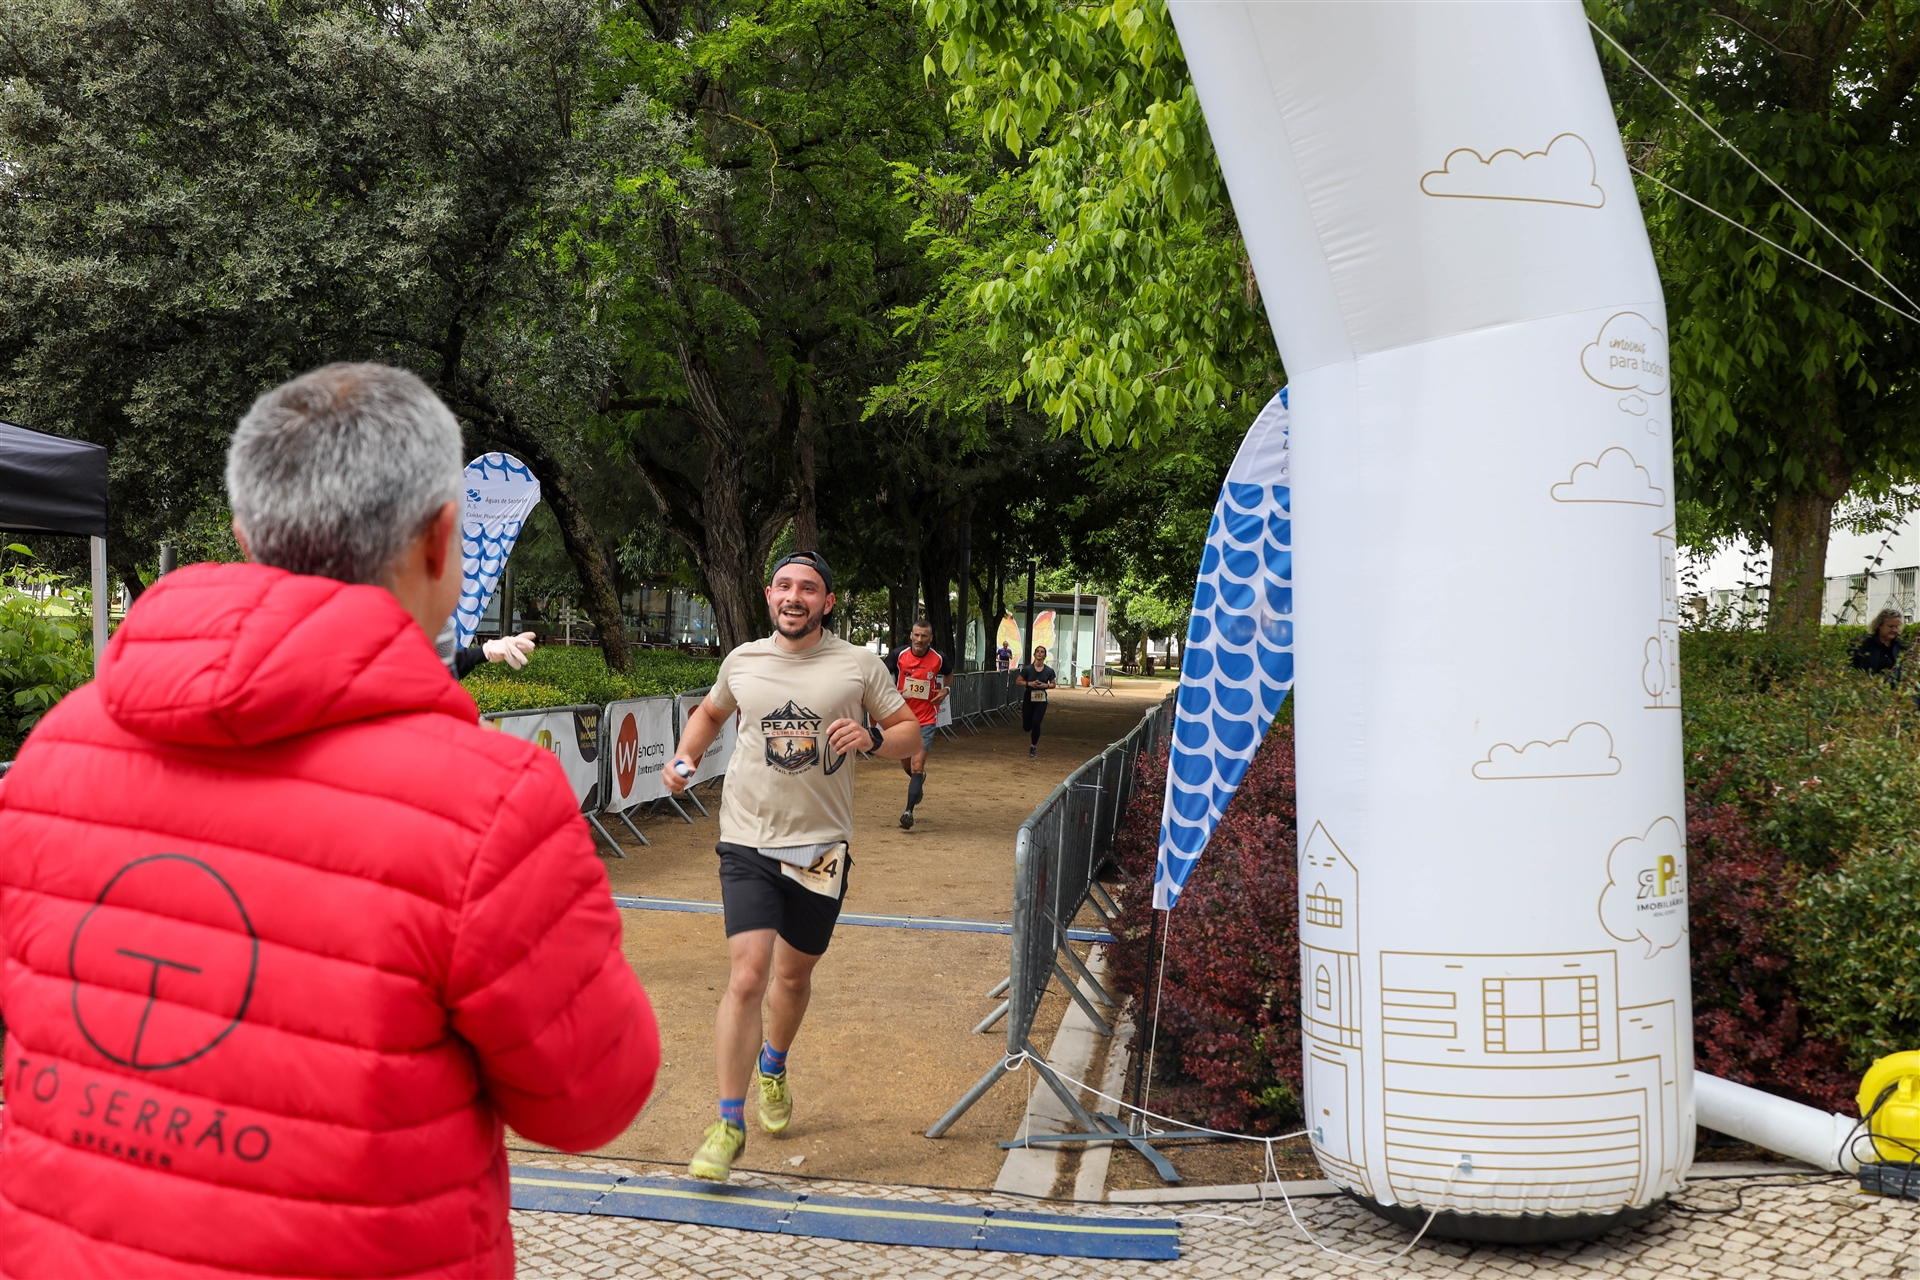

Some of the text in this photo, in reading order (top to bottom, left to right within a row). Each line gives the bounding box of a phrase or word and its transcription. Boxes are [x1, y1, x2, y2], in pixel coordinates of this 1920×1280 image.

[1610, 355, 1664, 377] para todos
[485, 496, 500, 505] Águas
[910, 684, 924, 693] 139
[761, 720, 822, 732] PEAKY
[618, 739, 637, 775] W
[773, 765, 812, 775] TRAIL RUNNING
[800, 856, 838, 878] 24
[13, 1057, 271, 1162] TÓ SERRÃO
[71, 1129, 173, 1168] SPEAKER
